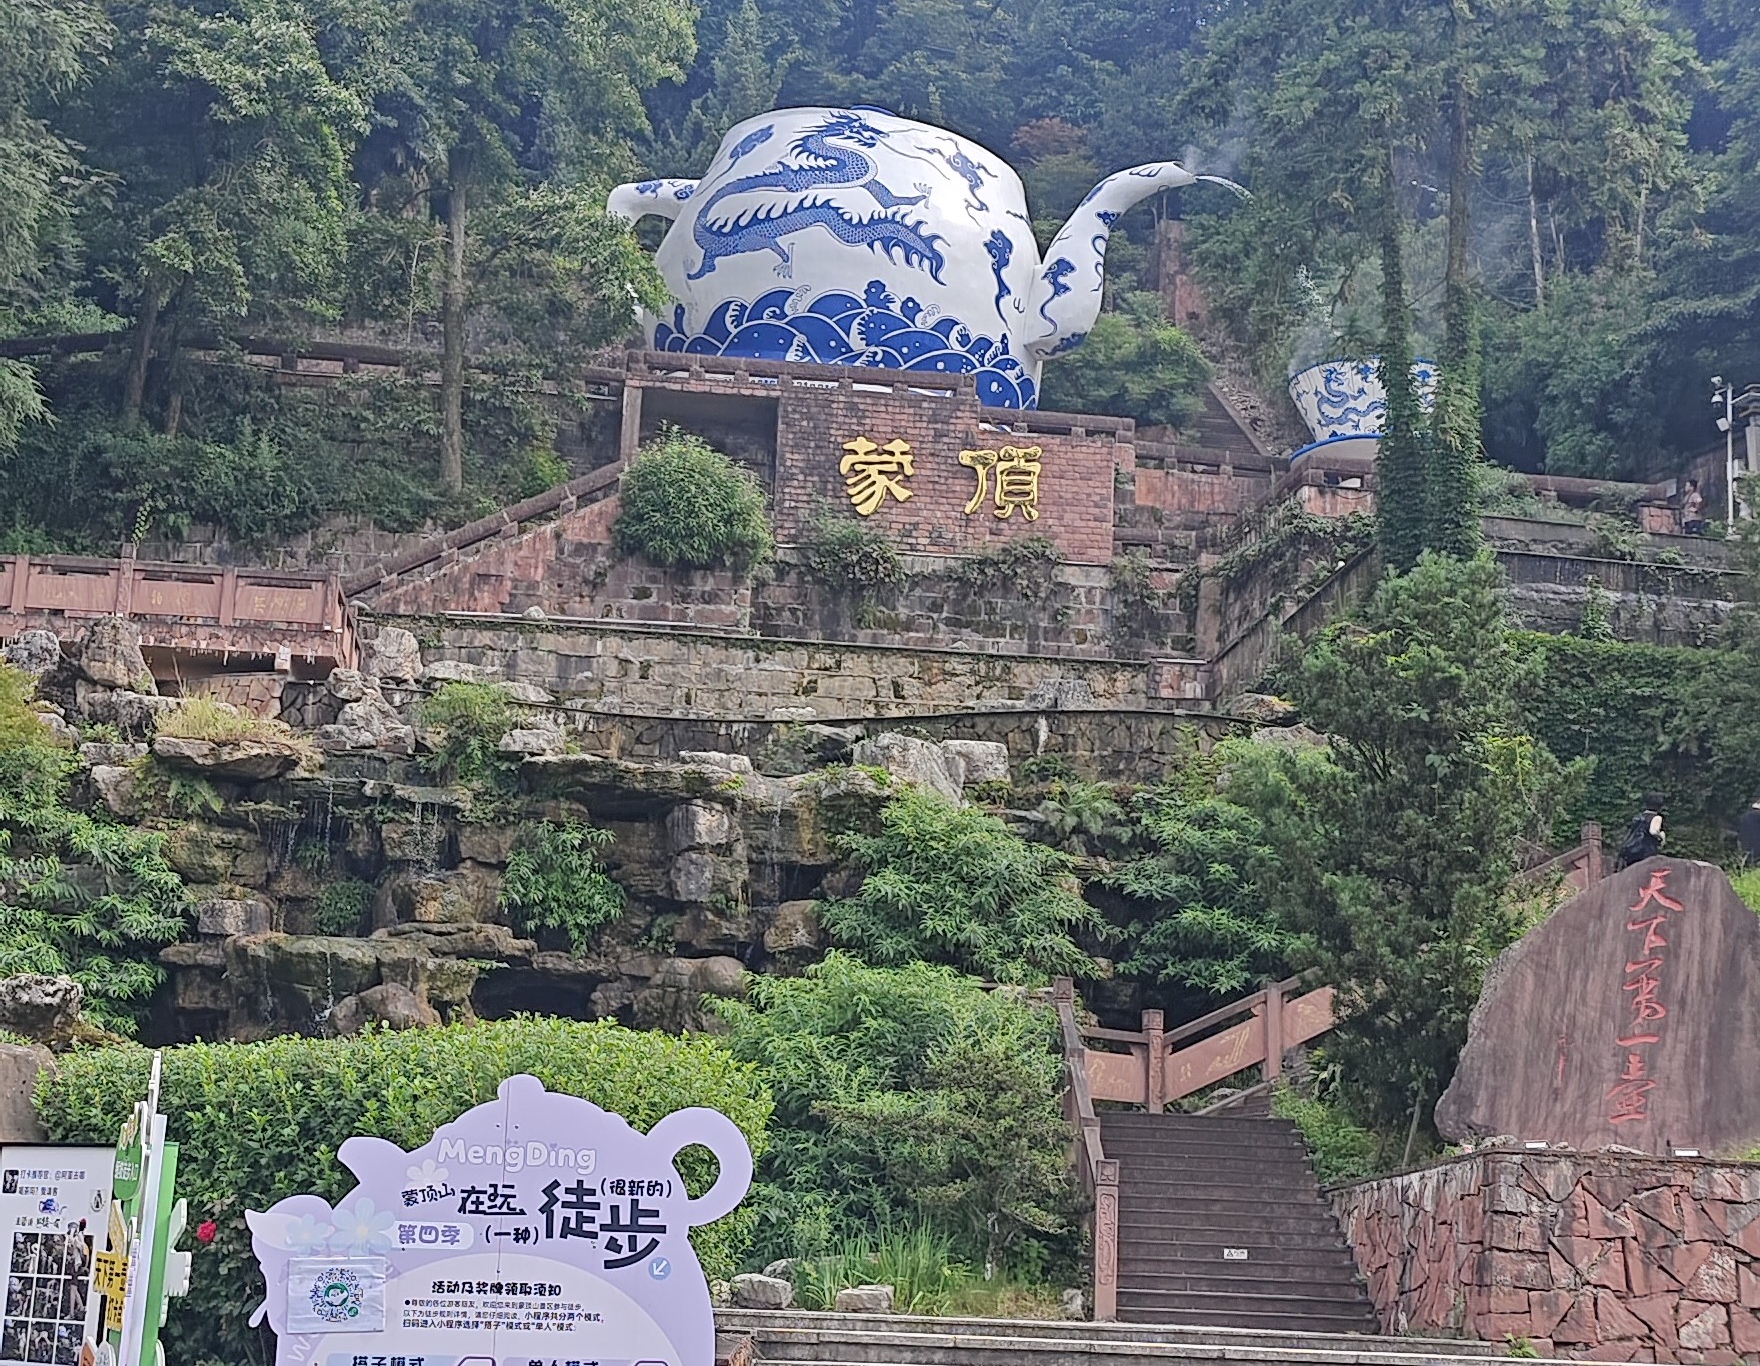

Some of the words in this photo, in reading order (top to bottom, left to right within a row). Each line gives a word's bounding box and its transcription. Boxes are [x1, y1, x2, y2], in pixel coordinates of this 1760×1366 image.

[437, 1138, 597, 1175] MengDing
[398, 1224, 461, 1245] 第四季
[401, 1183, 456, 1207] 蒙顶山
[538, 1179, 667, 1270] 徒步
[431, 1280, 562, 1297] 活动及奖牌领取须知
